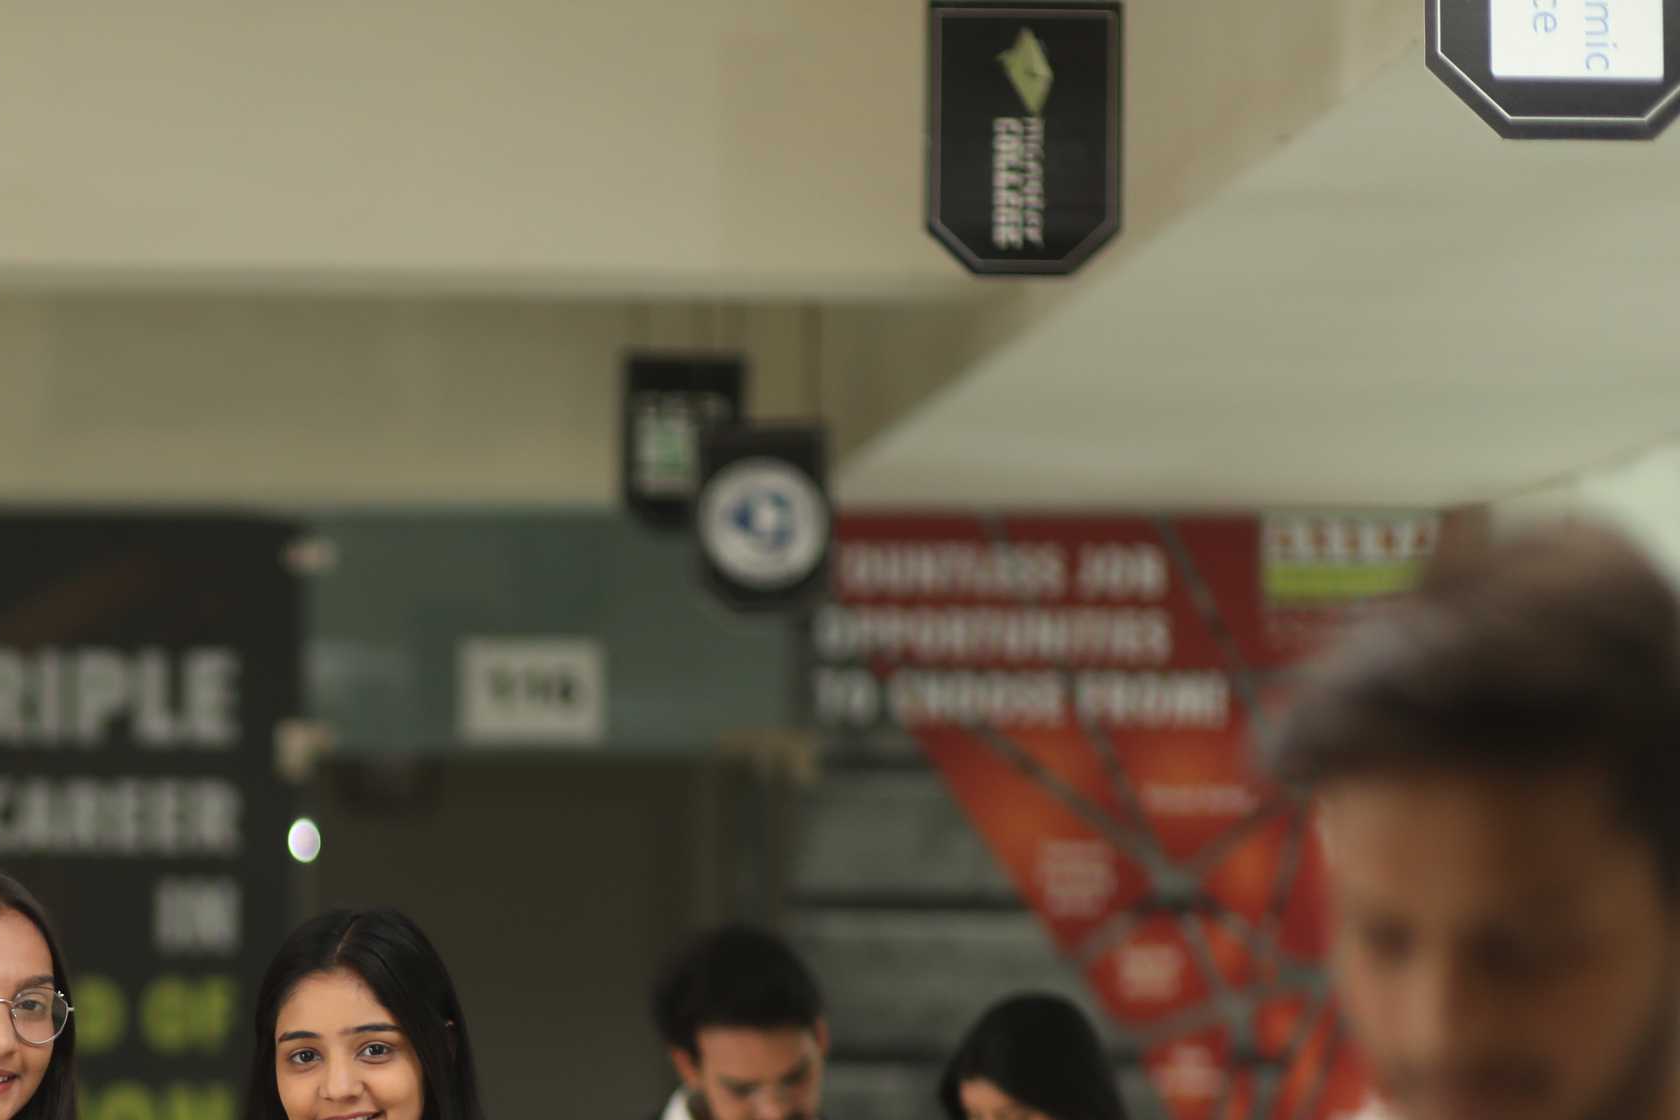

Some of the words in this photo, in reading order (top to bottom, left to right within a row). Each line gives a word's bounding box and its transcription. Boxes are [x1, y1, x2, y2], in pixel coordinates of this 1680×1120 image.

[1585, 0, 1618, 71] mic
[992, 116, 1023, 249] COLLEGE
[839, 540, 1066, 597] OUNTLESS
[1078, 540, 1169, 598] JOB
[816, 604, 1173, 663] OPPORTUNITIES
[815, 668, 878, 728] TO
[887, 668, 1064, 728] CHOOSE
[152, 877, 241, 952] IN
[140, 973, 235, 1055] OF
